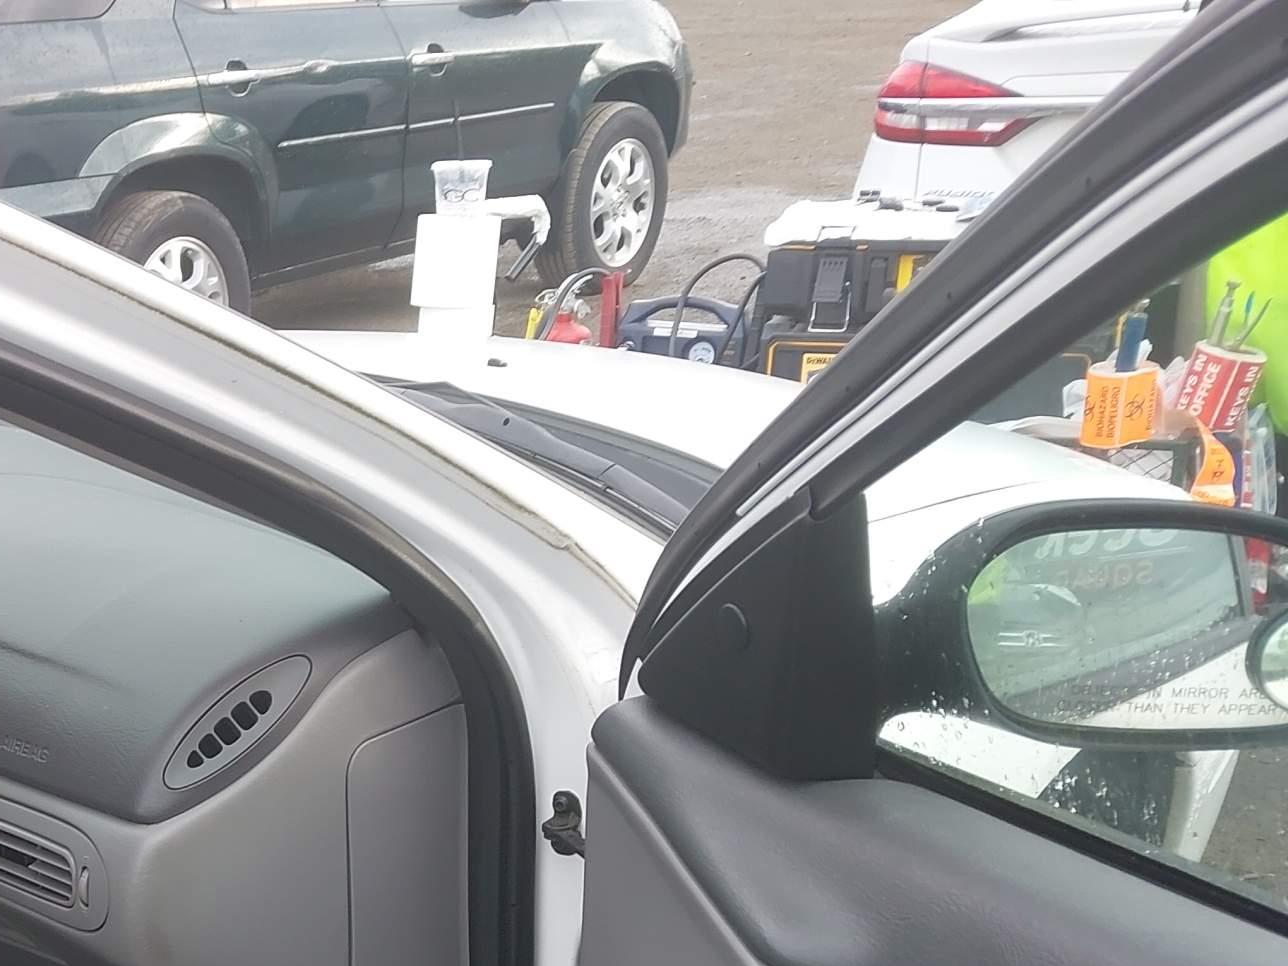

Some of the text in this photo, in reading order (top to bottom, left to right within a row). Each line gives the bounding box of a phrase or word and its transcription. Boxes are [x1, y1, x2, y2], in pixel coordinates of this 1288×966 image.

[1193, 353, 1209, 372] IN
[1189, 361, 1222, 417] OFFICE
[1224, 386, 1250, 426] KEYS
[1244, 365, 1260, 383] IN
[1171, 687, 1230, 699] MIRROR
[1127, 703, 1163, 713] THAN
[1174, 703, 1211, 715] THEY
[1217, 703, 1277, 716] APPEAR
